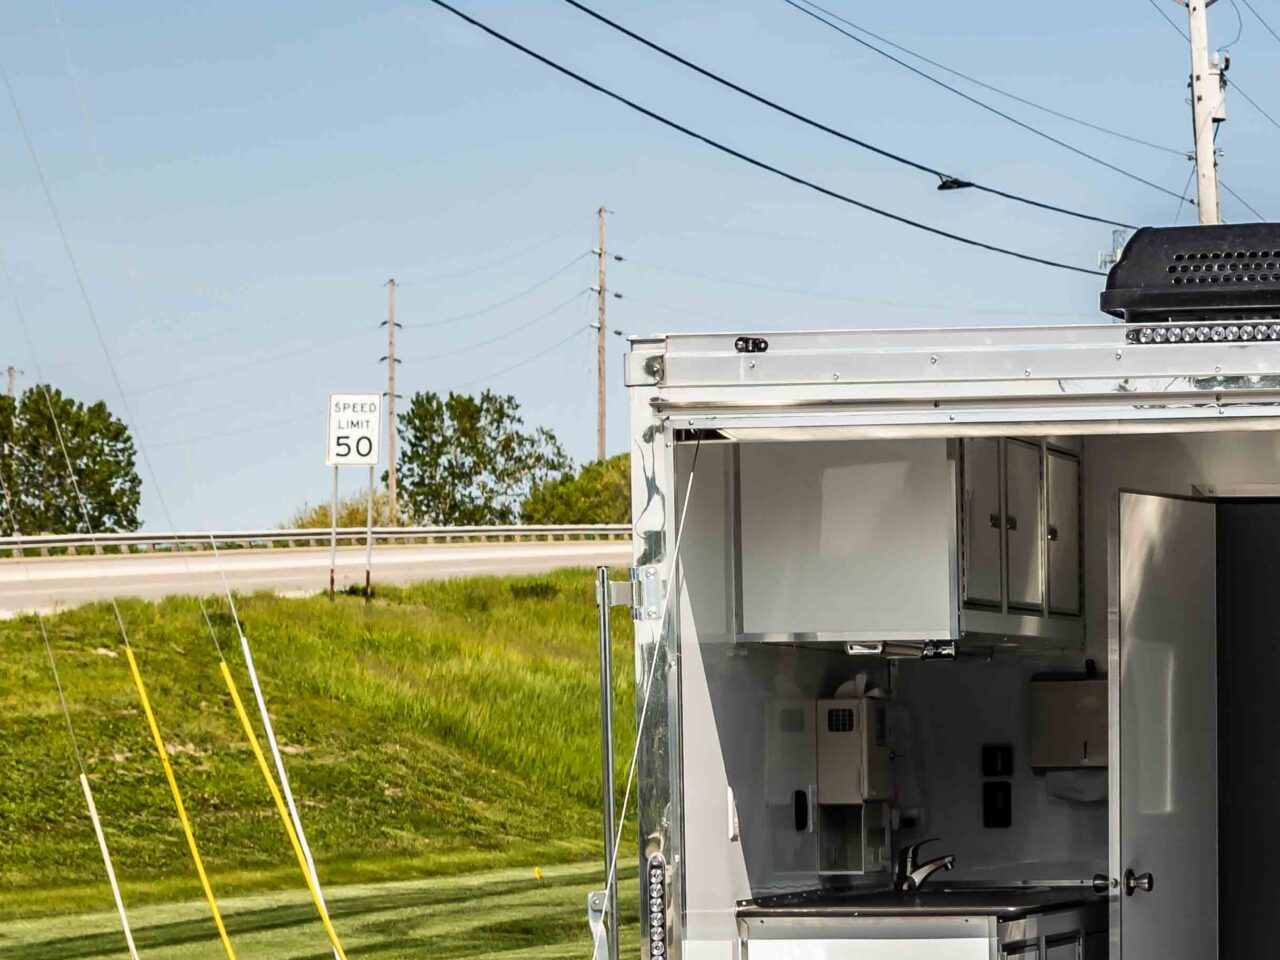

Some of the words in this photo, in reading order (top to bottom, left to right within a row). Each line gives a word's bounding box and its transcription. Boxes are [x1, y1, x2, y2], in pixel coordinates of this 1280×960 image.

[334, 402, 377, 413] SPEED
[338, 420, 370, 430] LIMIT
[336, 436, 373, 457] 50
